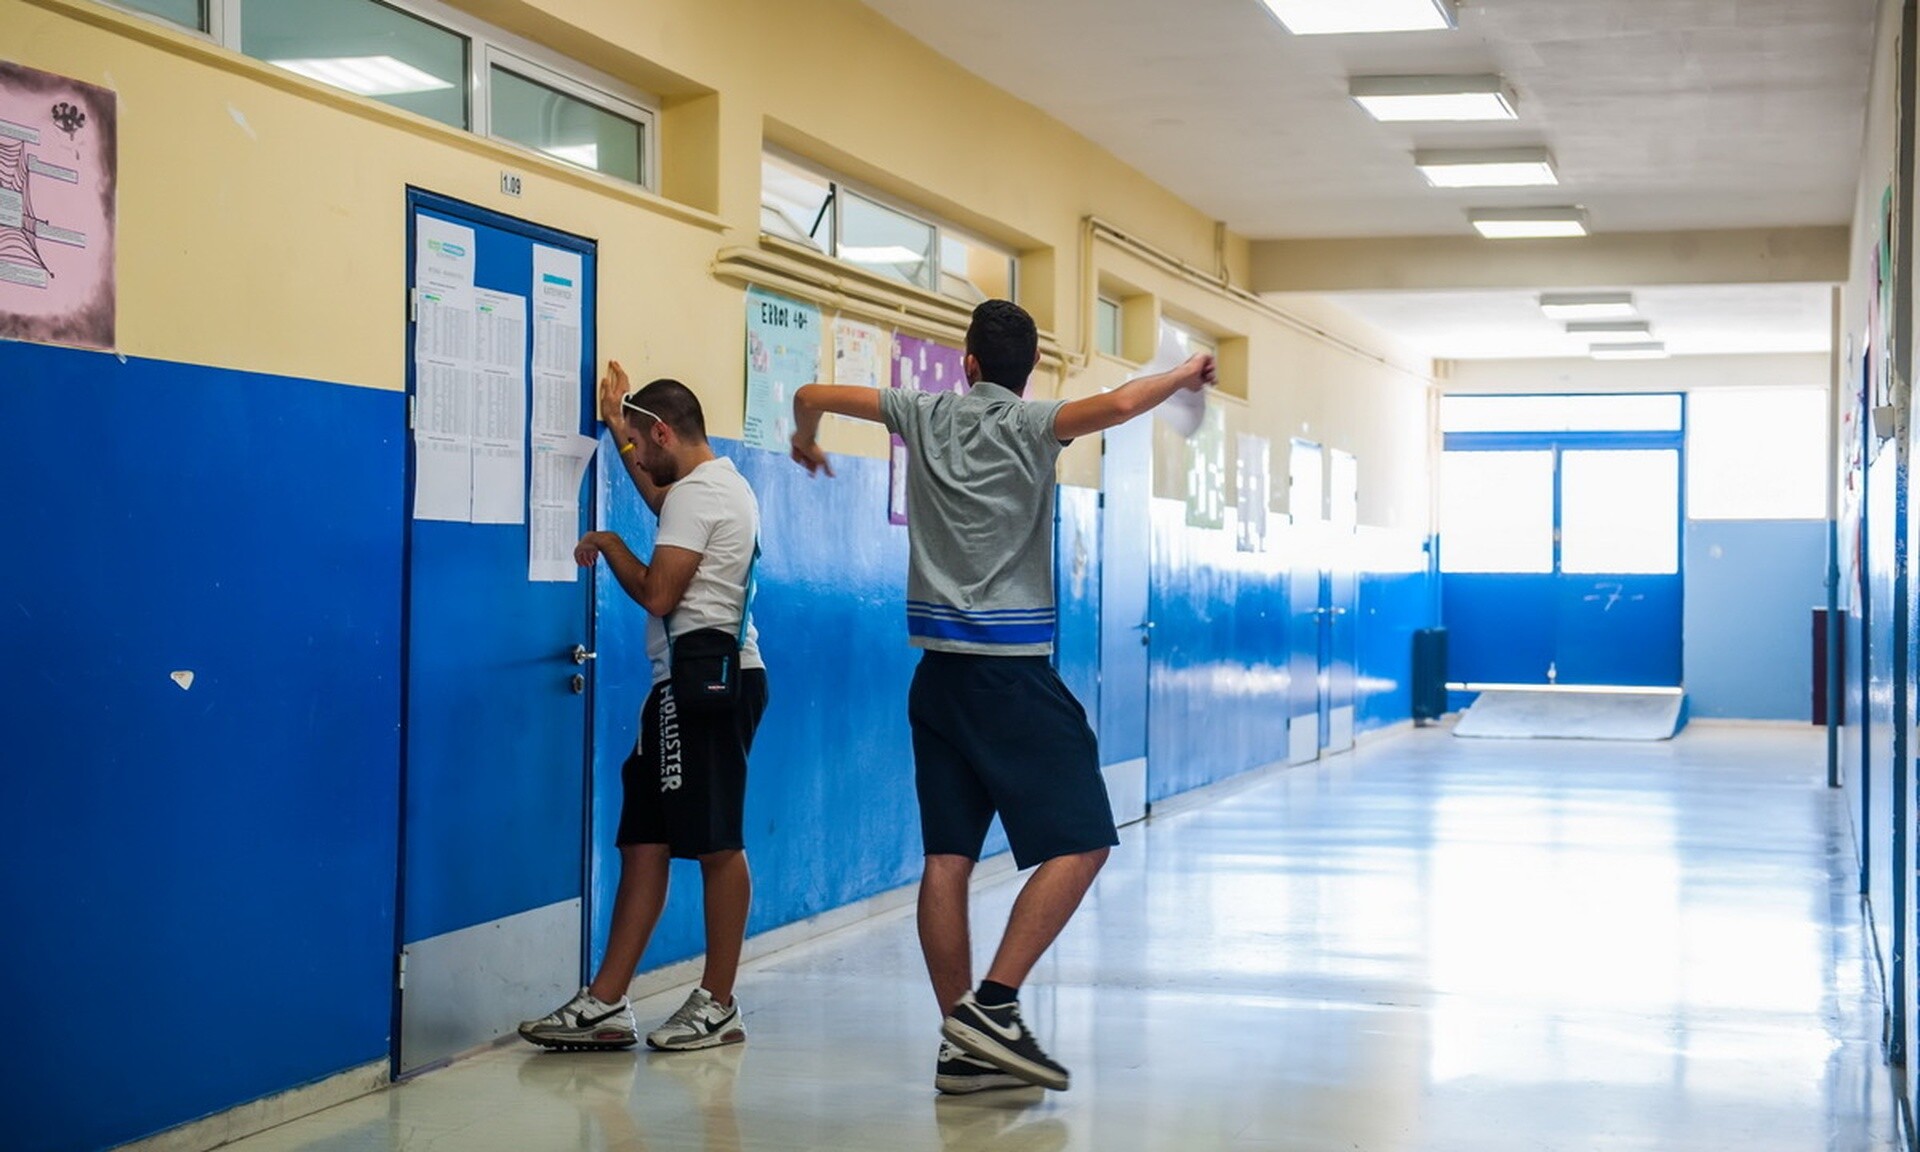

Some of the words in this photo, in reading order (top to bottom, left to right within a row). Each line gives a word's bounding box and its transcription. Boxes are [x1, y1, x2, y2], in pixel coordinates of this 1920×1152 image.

[503, 174, 521, 195] 1.09
[761, 302, 789, 327] ERROR
[660, 684, 682, 793] HOLLISTER
